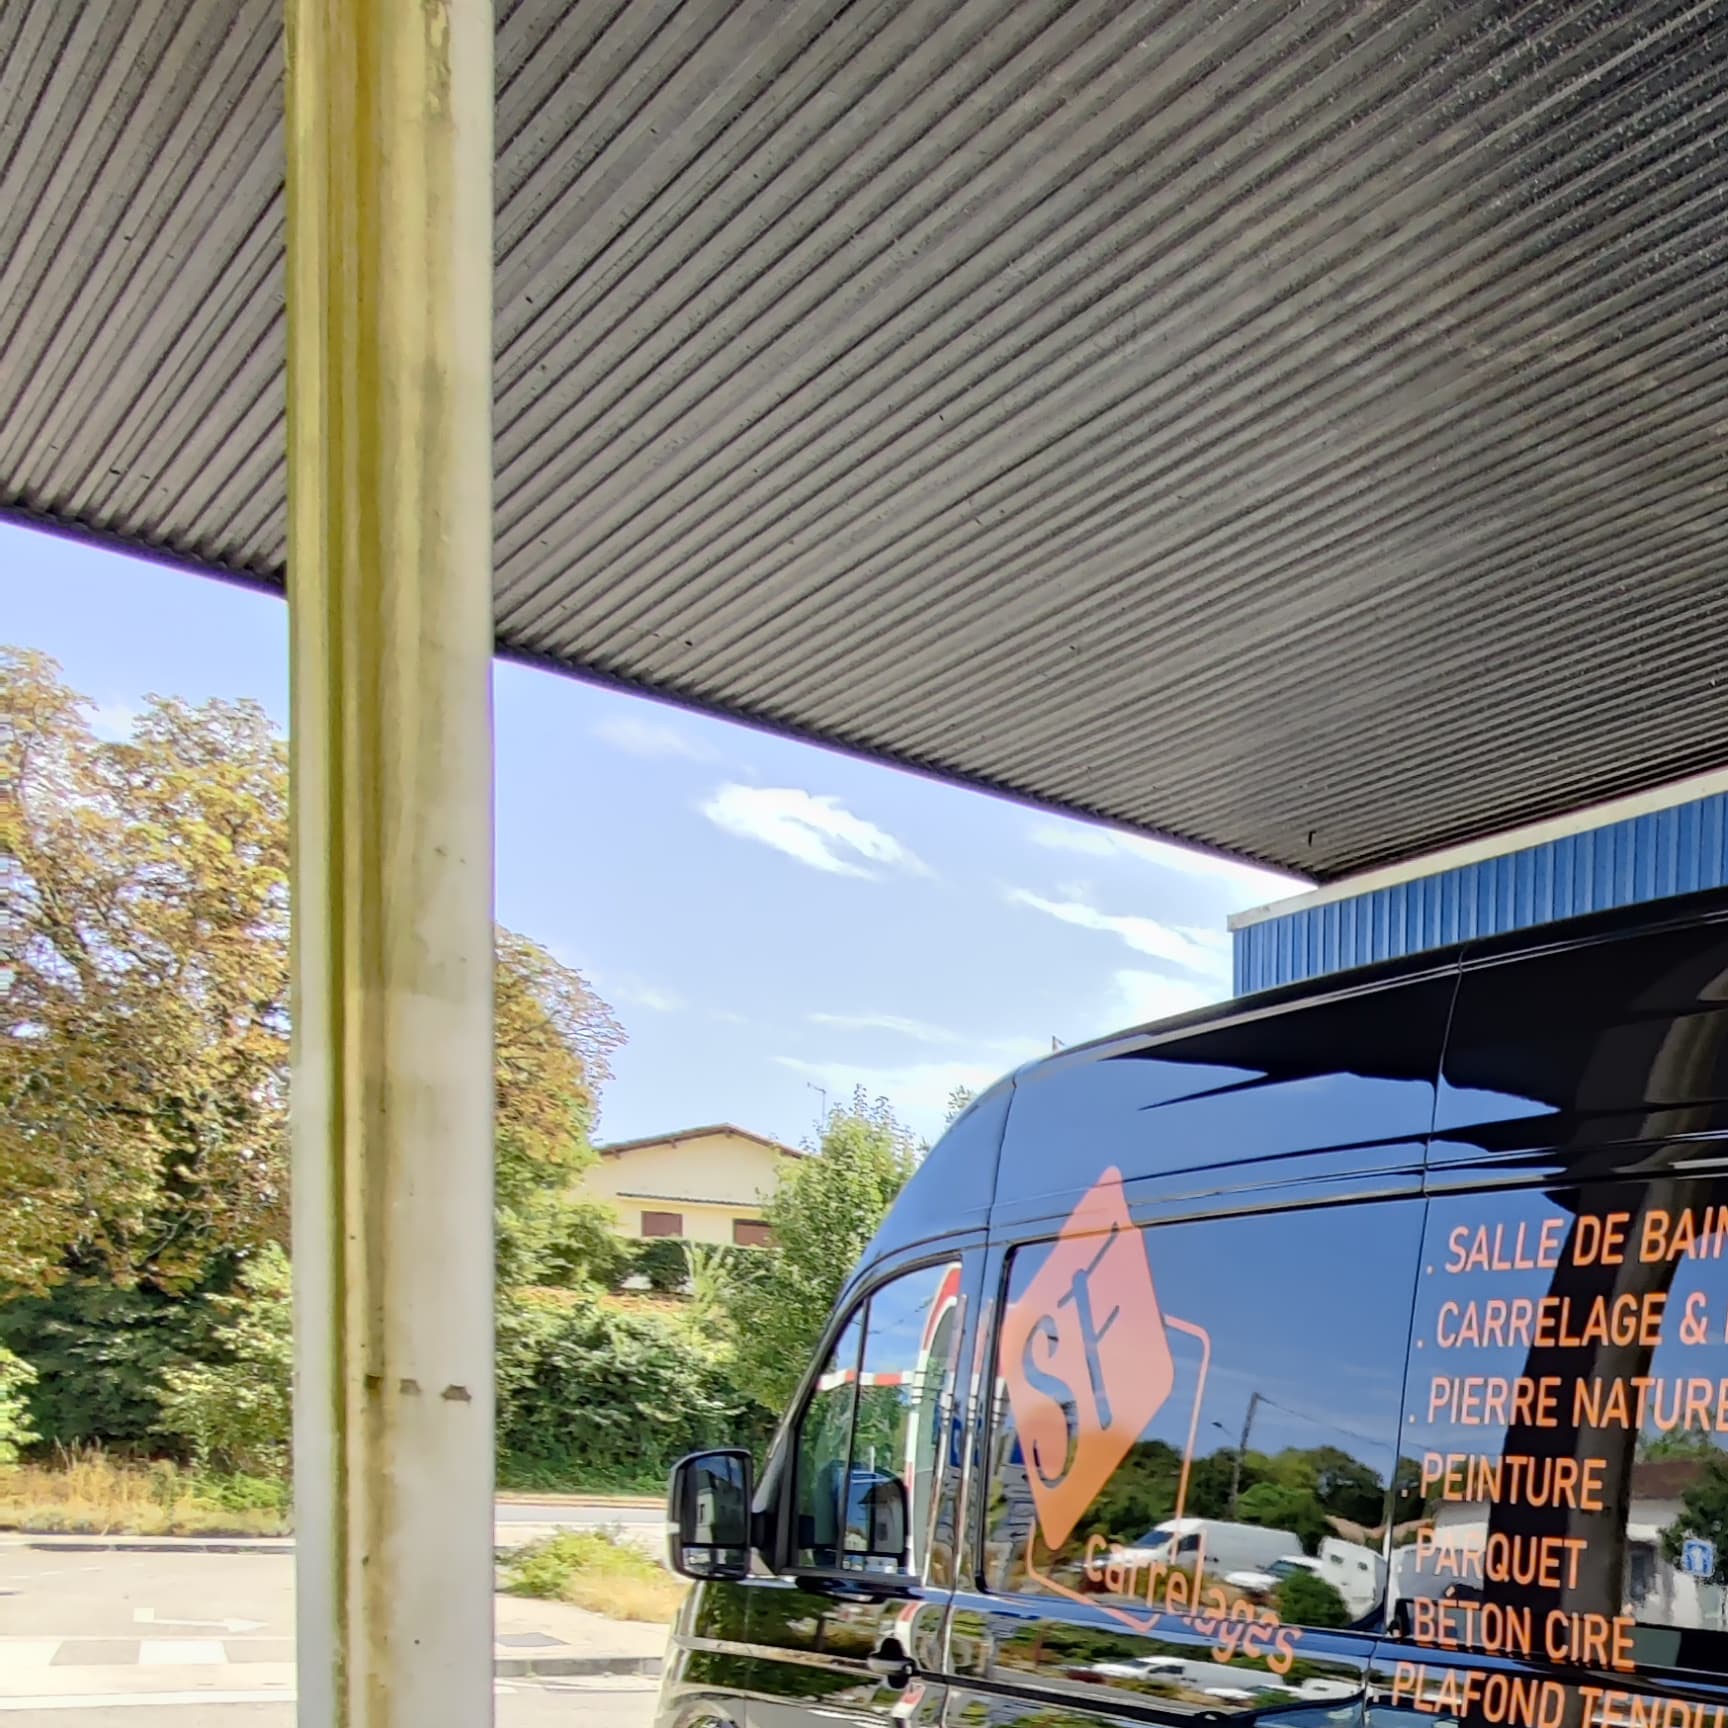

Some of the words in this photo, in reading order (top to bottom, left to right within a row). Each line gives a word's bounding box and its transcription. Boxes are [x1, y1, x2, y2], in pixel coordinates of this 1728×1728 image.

[1446, 1216, 1565, 1275] SALLE
[1572, 1211, 1624, 1267] DE
[1436, 1291, 1666, 1349] CARRELAGE
[1680, 1291, 1710, 1346] &
[1428, 1376, 1559, 1428] PIERRE
[1421, 1453, 1608, 1512] PEINTURE
[1416, 1528, 1588, 1590] PARQUET
[1086, 1526, 1303, 1675] carrelages
[1414, 1585, 1531, 1657] BÉTON
[1545, 1603, 1637, 1671] CIRÉ
